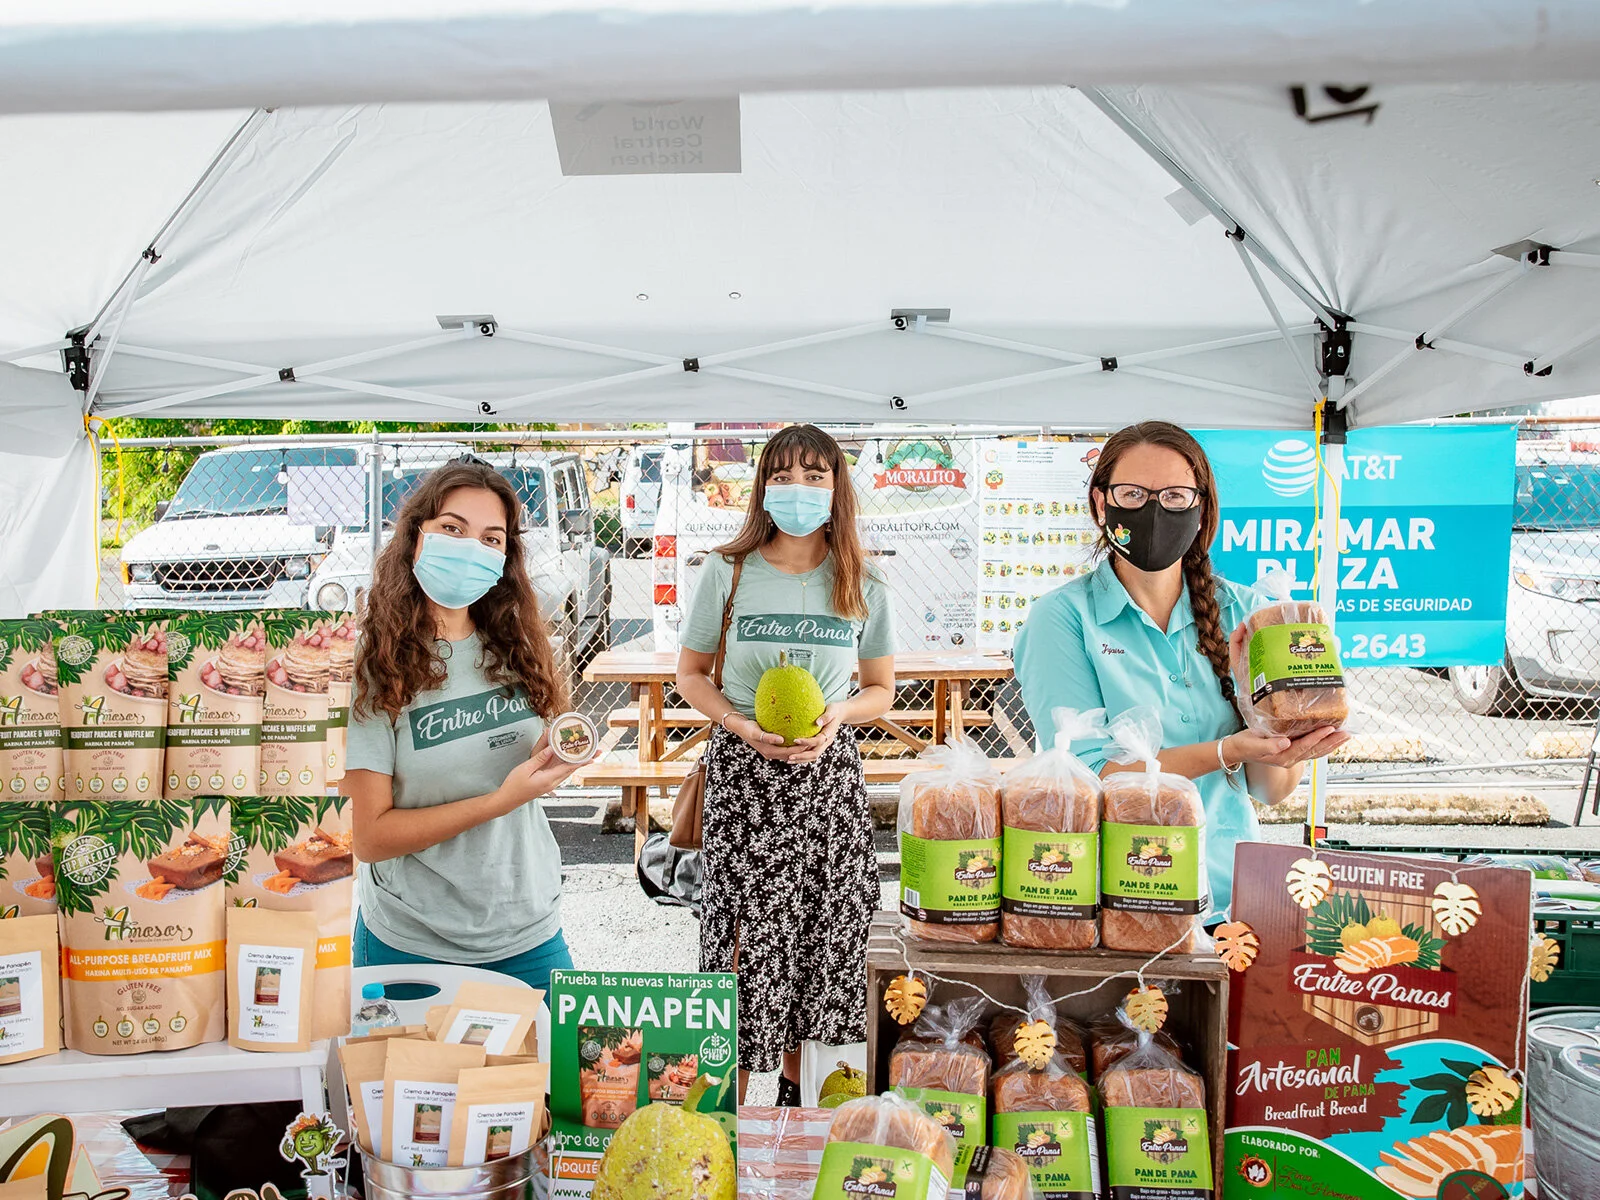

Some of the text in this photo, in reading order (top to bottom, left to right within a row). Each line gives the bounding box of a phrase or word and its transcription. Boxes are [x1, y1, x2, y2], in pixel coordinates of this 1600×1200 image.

[885, 470, 955, 484] MORALITO
[1256, 557, 1399, 591] PLZA
[1360, 599, 1379, 611] DE
[1383, 598, 1472, 612] SEGURIDAD
[740, 617, 852, 641] Entre Panas
[1335, 633, 1426, 659] .2643
[280, 725, 286, 733] &
[286, 725, 304, 733] WAFFLE
[305, 725, 316, 733] MIX
[416, 707, 484, 741] Entre
[13, 731, 38, 739] PANCAKE
[43, 730, 61, 738] WAFFL
[93, 730, 117, 738] PANCAKE
[117, 730, 122, 738] &
[145, 730, 155, 738] MIX
[191, 728, 213, 736] PANCAKE
[213, 728, 219, 736] &
[219, 728, 240, 736] WAFFLE
[240, 728, 250, 736] MIX
[12, 750, 46, 760] GLUTEN FREE
[92, 750, 125, 760] GLUTEN FREE
[61, 846, 116, 874] SUPERFOOD
[1029, 862, 1048, 872] Entre
[1128, 856, 1148, 865] Entre
[1329, 864, 1425, 891] GLUTEN FREE
[1020, 885, 1038, 894] PAN
[1054, 888, 1078, 896] PANA
[1119, 880, 1137, 888] PAN
[1153, 883, 1179, 891] PANA
[104, 906, 193, 941] Amasar
[318, 943, 337, 953] MIX
[70, 948, 212, 965] ALL-PURPOSE BREADFRUIT MIX
[85, 969, 110, 977] HARINA
[554, 972, 734, 989] Prueba las nuevas harinas de
[1293, 963, 1452, 1008] Entre Panas
[116, 982, 162, 995] GLUTEN FREE
[558, 988, 731, 1030] PANAPÉN
[703, 1047, 728, 1055] GLUTEN
[1306, 1047, 1341, 1068] PAN
[1235, 1054, 1361, 1096] Artesanal
[1324, 1083, 1376, 1099] DE PANA
[1264, 1098, 1368, 1121] Breadfruit Bread
[584, 1132, 600, 1147] de
[1141, 1141, 1162, 1151] Entre
[1241, 1134, 1321, 1159] ELABORADO POR:
[555, 1160, 599, 1174] ADQUIÉ
[1135, 1168, 1197, 1178] PAN DE PANA
[1045, 1173, 1071, 1181] PANA
[844, 1180, 896, 1197] Entre Panas
